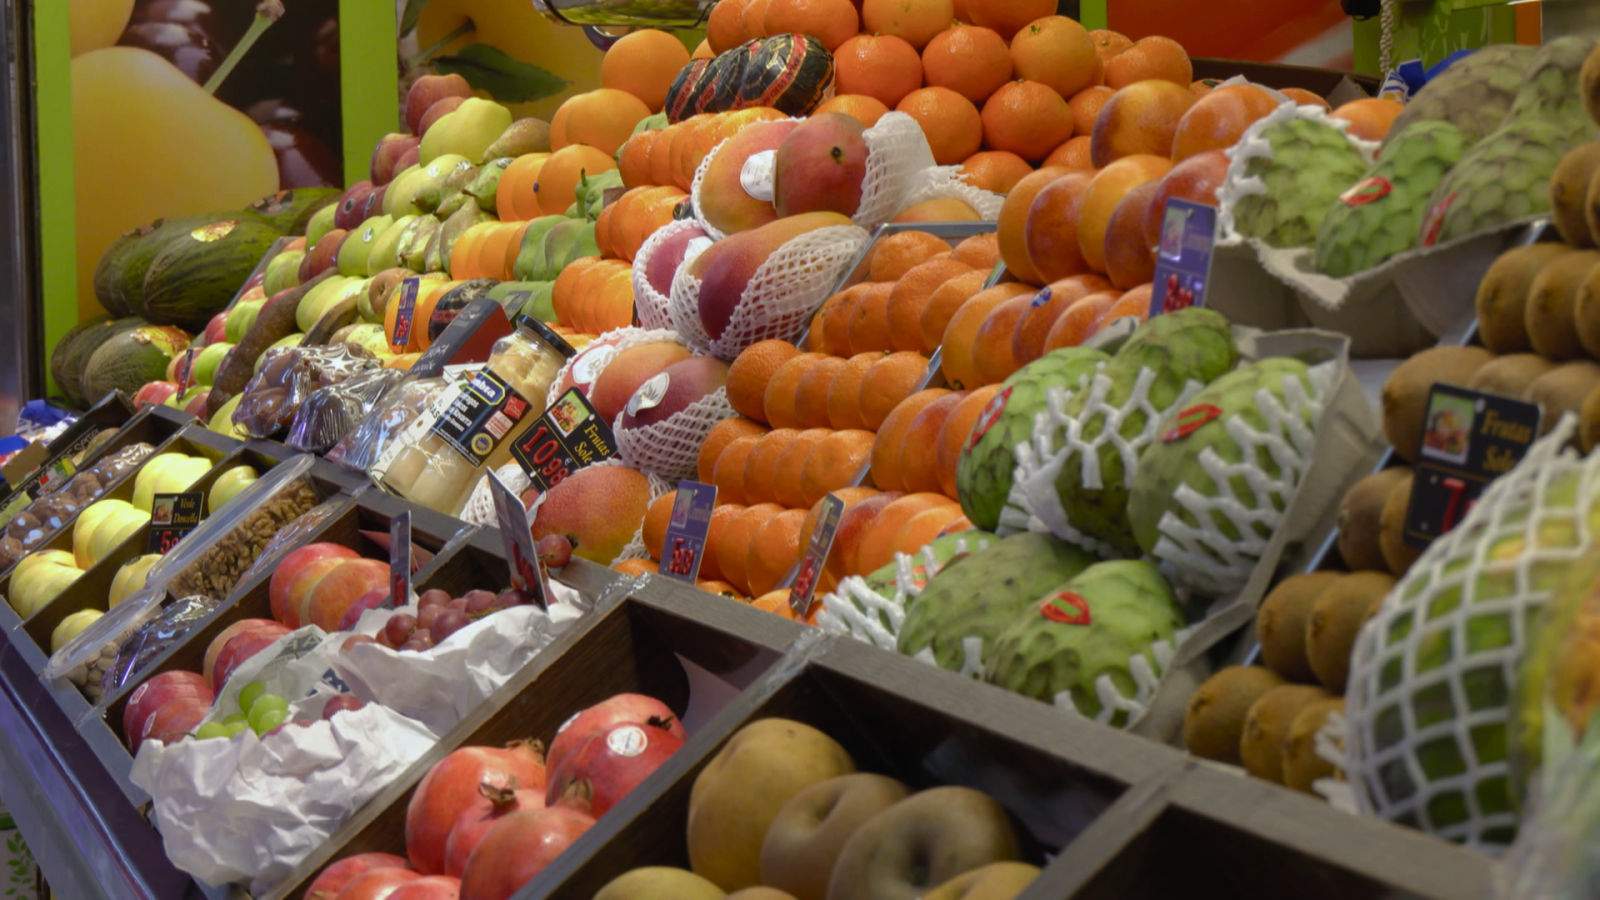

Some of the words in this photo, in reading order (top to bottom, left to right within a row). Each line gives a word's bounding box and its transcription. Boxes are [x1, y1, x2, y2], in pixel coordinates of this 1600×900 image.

[584, 424, 611, 456] Frutas
[1480, 410, 1533, 444] Frutas
[180, 497, 196, 509] Verde
